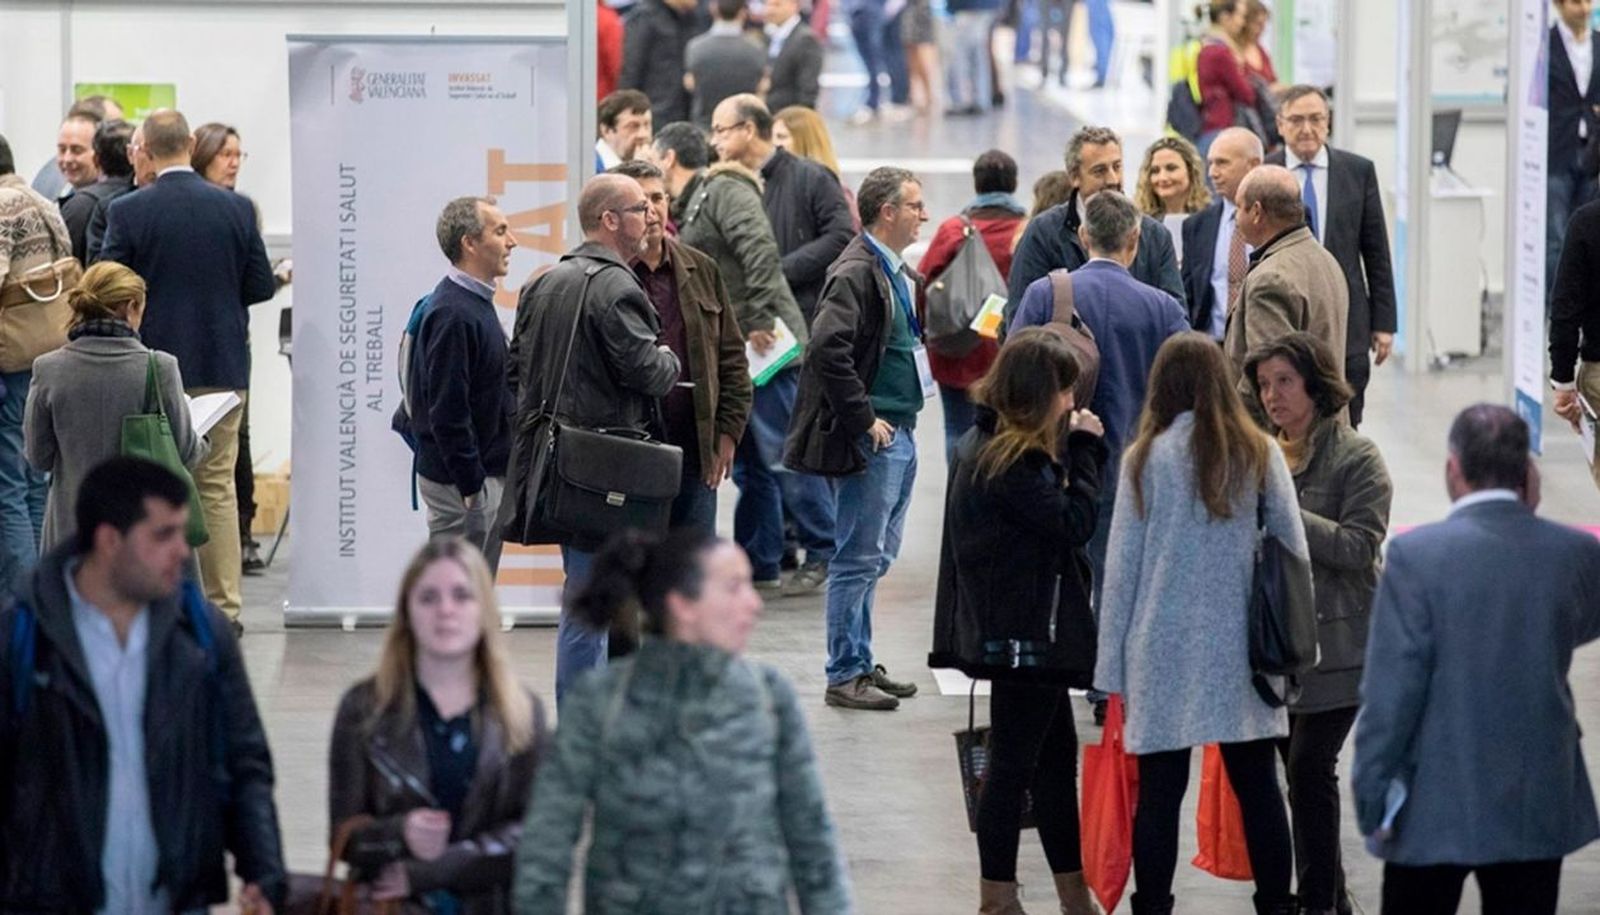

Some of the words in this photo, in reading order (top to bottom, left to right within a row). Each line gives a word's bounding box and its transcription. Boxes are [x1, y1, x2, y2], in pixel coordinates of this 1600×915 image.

[367, 72, 427, 85] GENERALITAT
[367, 85, 427, 99] VALENCIANA
[448, 72, 492, 83] INVASSAT
[339, 163, 356, 223] SALUT
[339, 238, 356, 345] SEGURETAT
[339, 349, 356, 374] DE
[366, 305, 383, 384] TREBALL
[366, 389, 383, 412] AL
[337, 380, 356, 471] VALENCIÀ
[339, 476, 356, 557] INSTITUT
